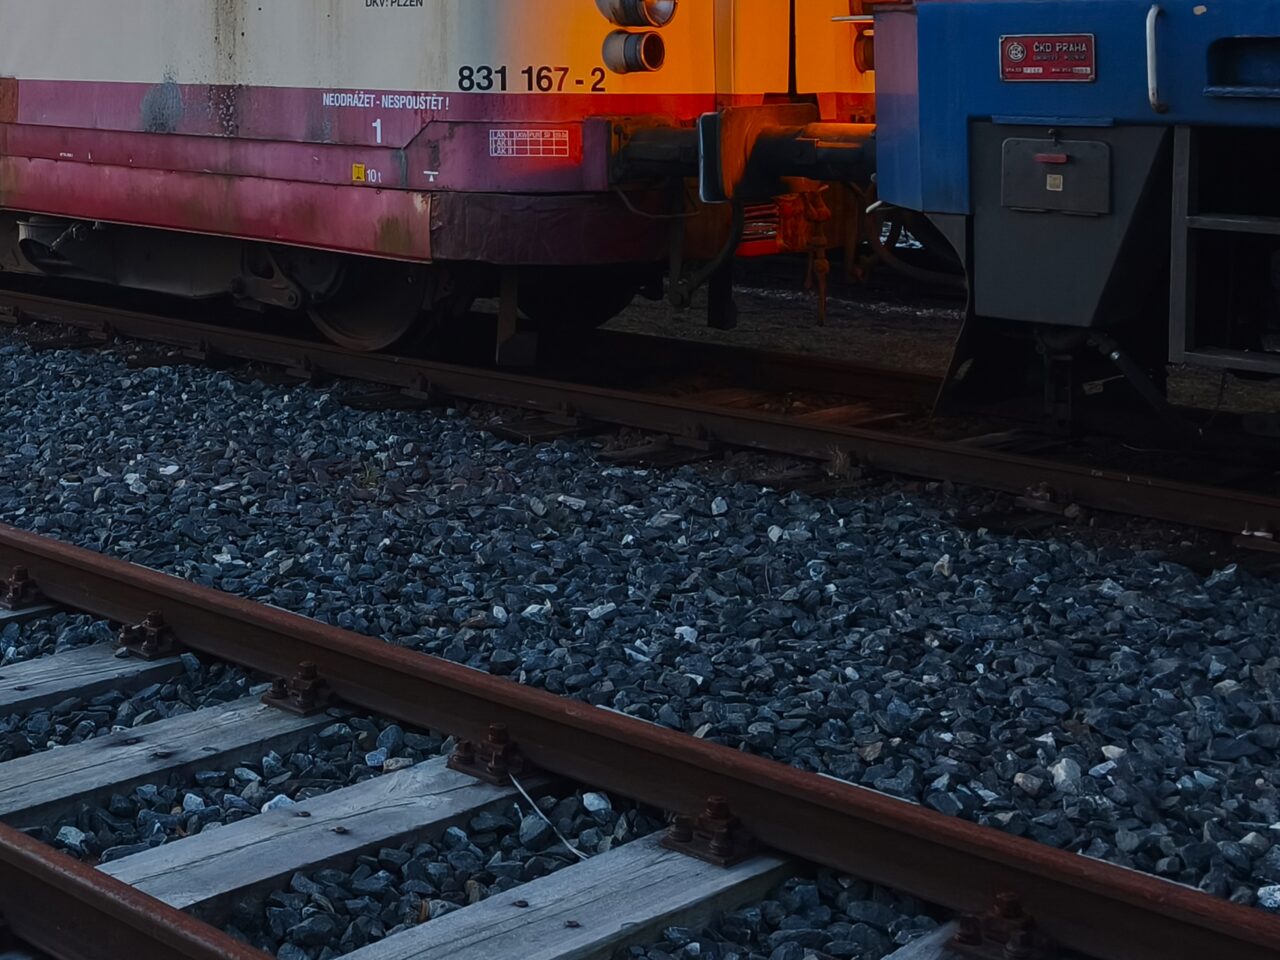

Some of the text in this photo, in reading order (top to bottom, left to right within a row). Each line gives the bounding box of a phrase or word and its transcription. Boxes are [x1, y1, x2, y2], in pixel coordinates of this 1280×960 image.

[1055, 42, 1087, 52] PRAHA
[458, 65, 507, 91] 831
[521, 65, 570, 92] 167
[590, 66, 606, 92] 2
[322, 90, 376, 108] NEODRÁŽET
[381, 93, 444, 110] NESPOUŠTĚT
[371, 118, 382, 144] 1
[366, 168, 377, 183] 10
